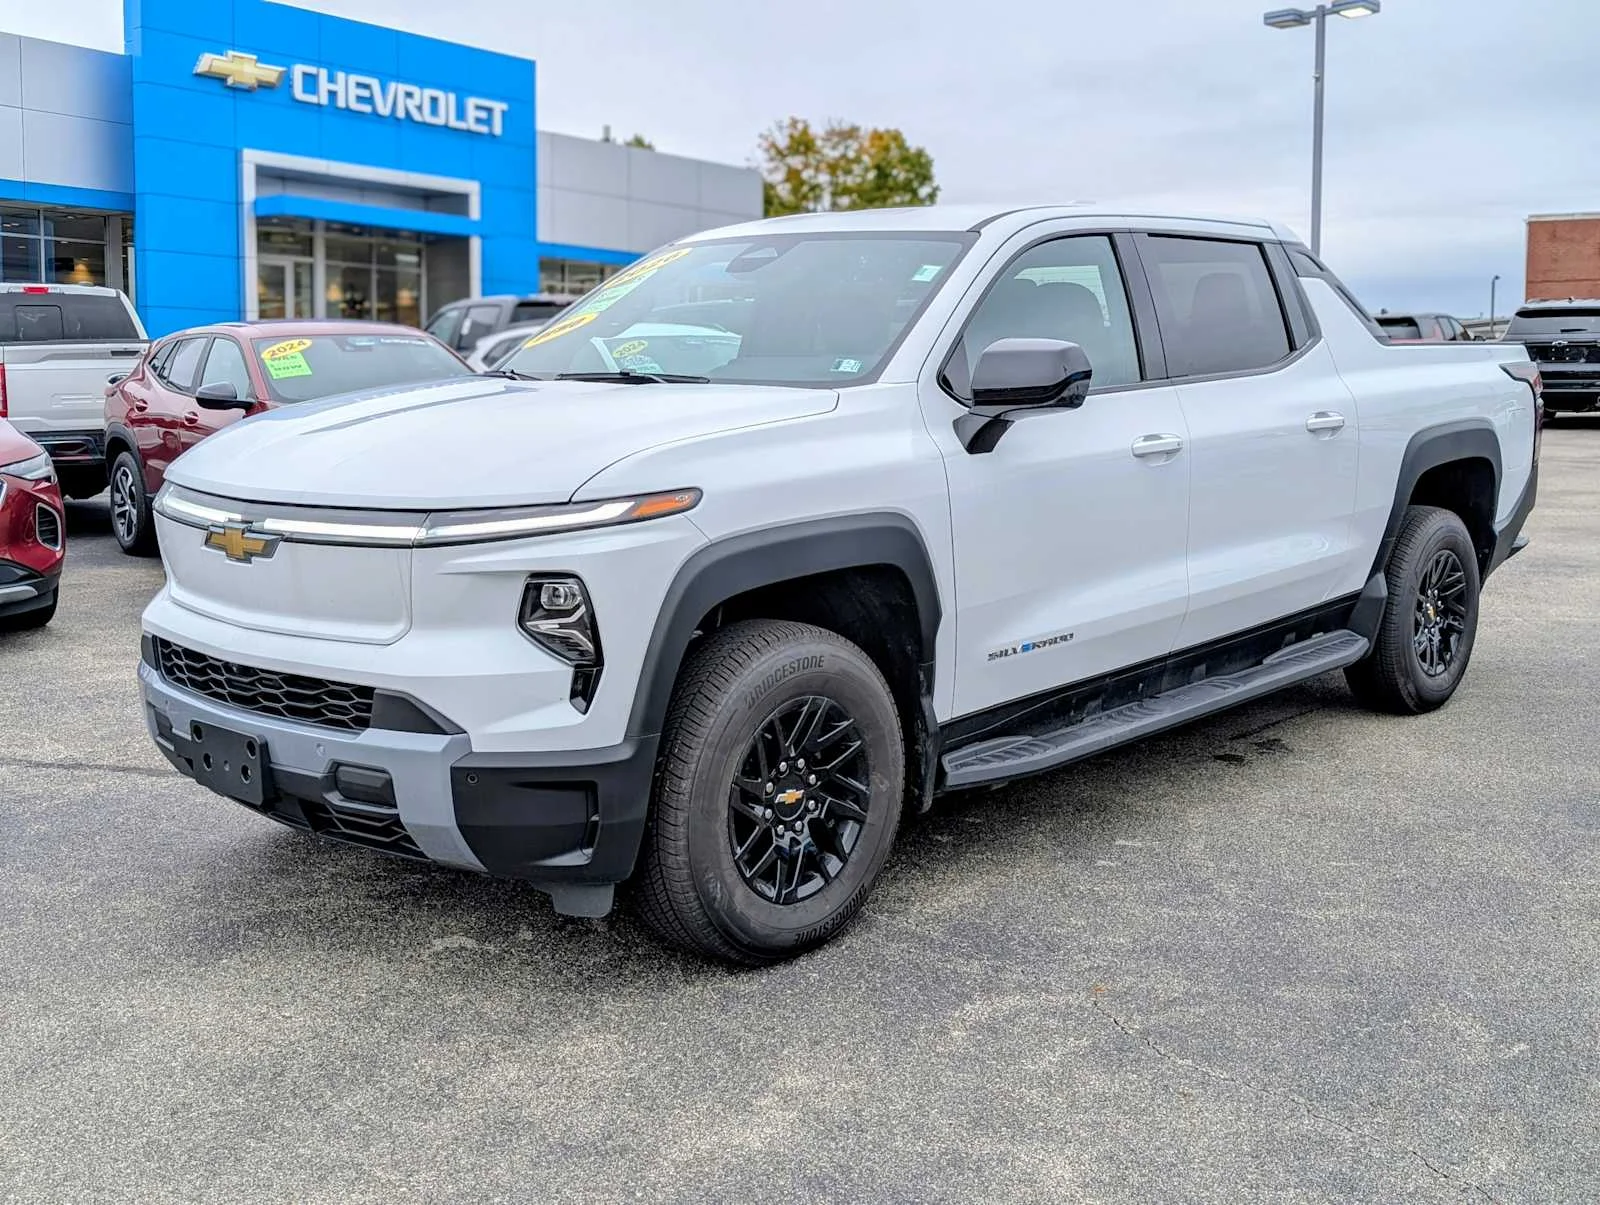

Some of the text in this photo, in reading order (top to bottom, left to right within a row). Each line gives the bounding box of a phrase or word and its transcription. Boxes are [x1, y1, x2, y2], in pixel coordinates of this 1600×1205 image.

[292, 63, 508, 136] CHEVROLET
[267, 340, 307, 357] 2024
[987, 632, 1074, 661] SILVERADO
[743, 655, 825, 709] BRIDGESTONE
[792, 882, 867, 945] BRIDGESTONE
